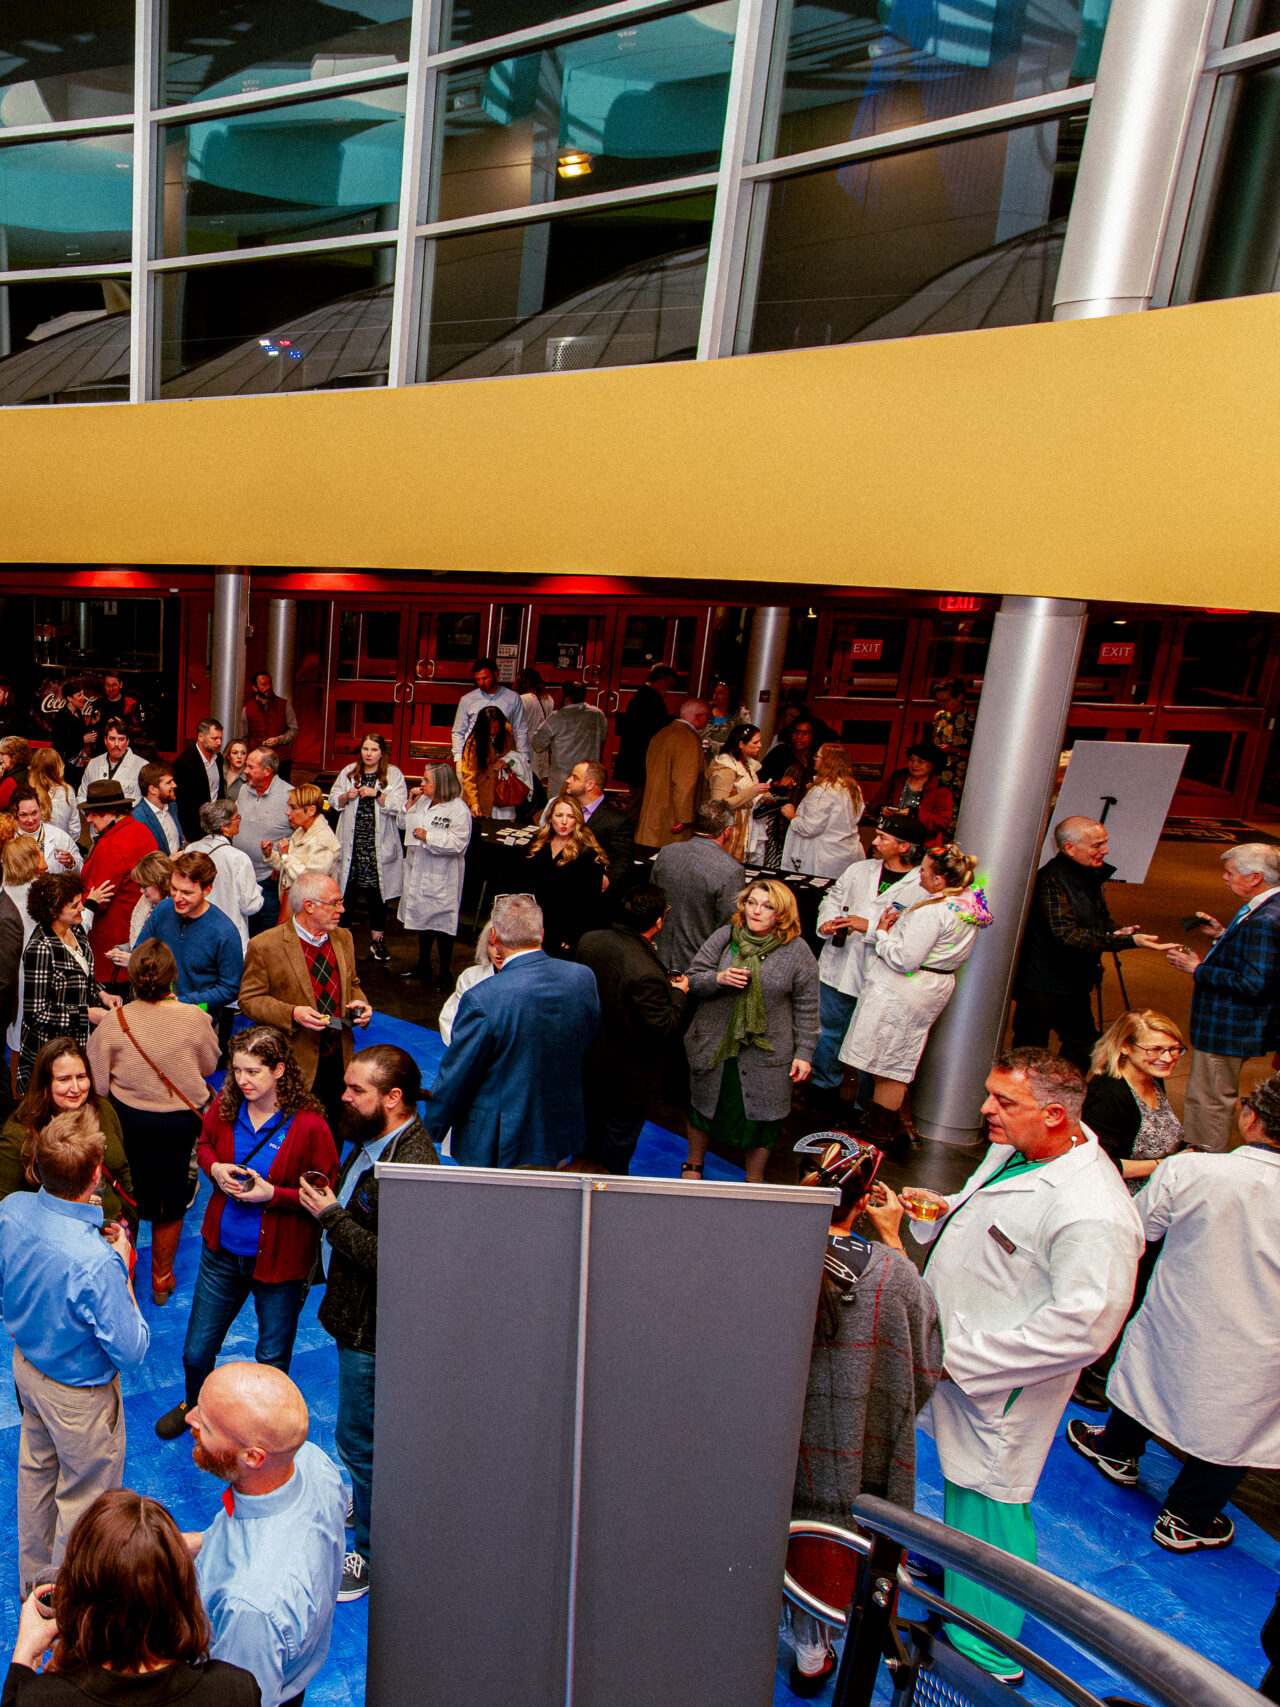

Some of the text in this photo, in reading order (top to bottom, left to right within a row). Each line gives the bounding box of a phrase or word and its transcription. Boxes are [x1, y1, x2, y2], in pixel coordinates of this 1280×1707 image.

[947, 597, 975, 609] EXIT
[853, 643, 881, 653] EXIT
[1101, 647, 1132, 657] EXIT
